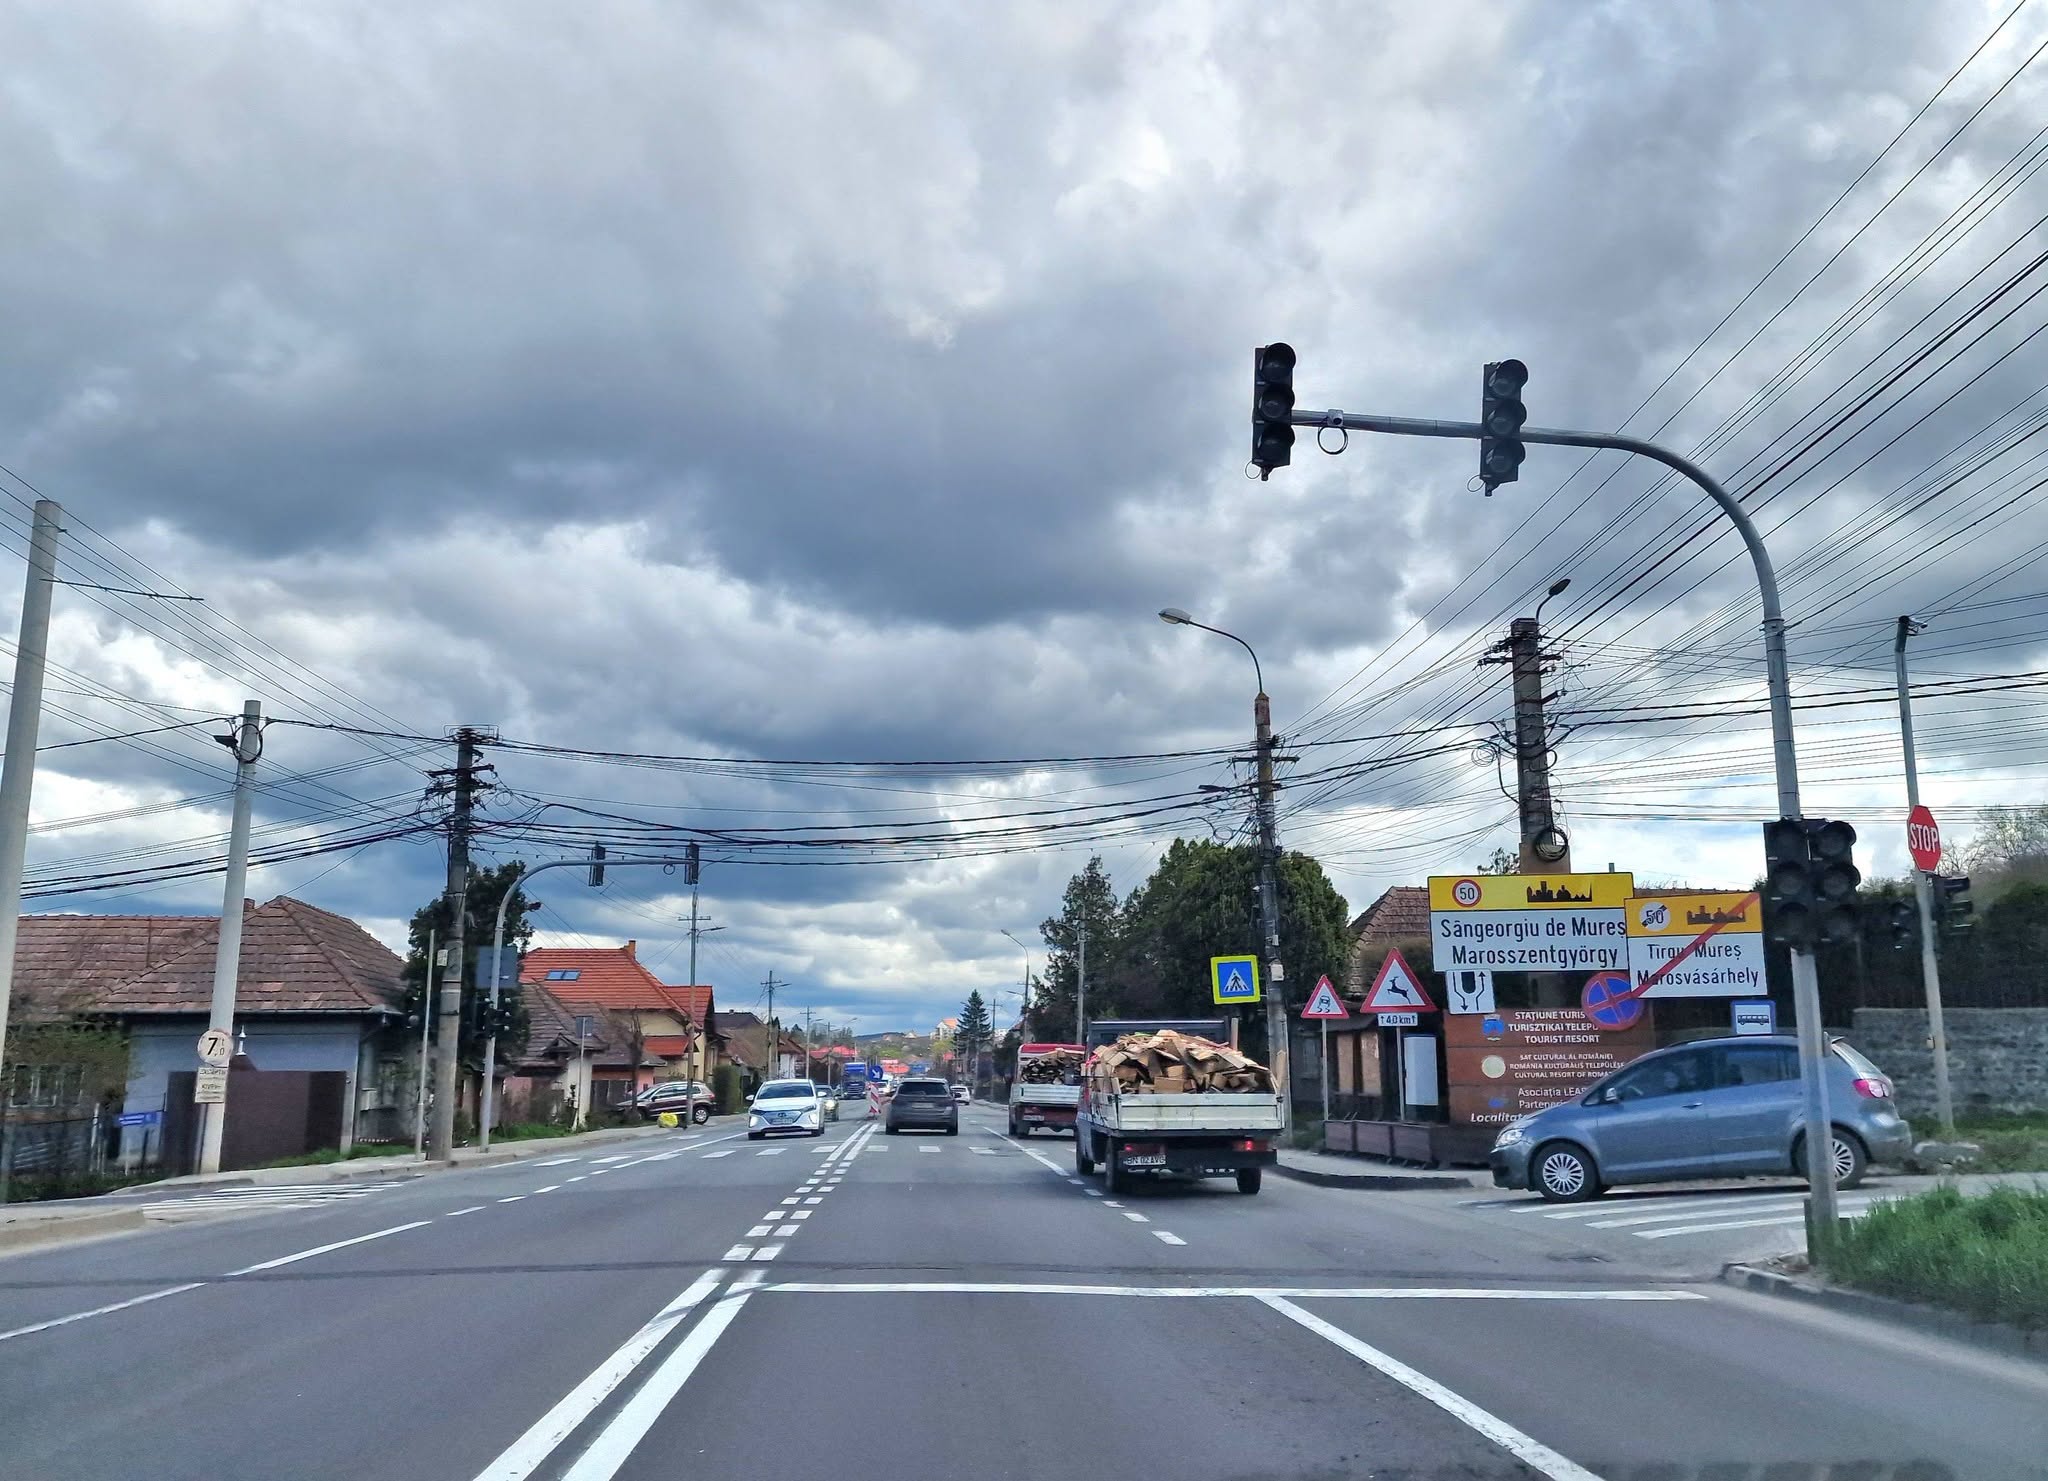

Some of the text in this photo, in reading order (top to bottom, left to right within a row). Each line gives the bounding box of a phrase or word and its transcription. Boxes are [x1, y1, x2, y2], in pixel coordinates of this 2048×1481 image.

[1910, 823, 1938, 853] STOP
[1459, 887, 1475, 900] 50
[1441, 917, 1626, 942] Sângeorgiu de Mureș
[1452, 945, 1617, 968] Marosszentgyörgy
[1399, 1015, 1411, 1024] km
[1508, 1023, 1564, 1031] TURISZTIKAI
[1525, 1035, 1600, 1043] TOURIST RESORT
